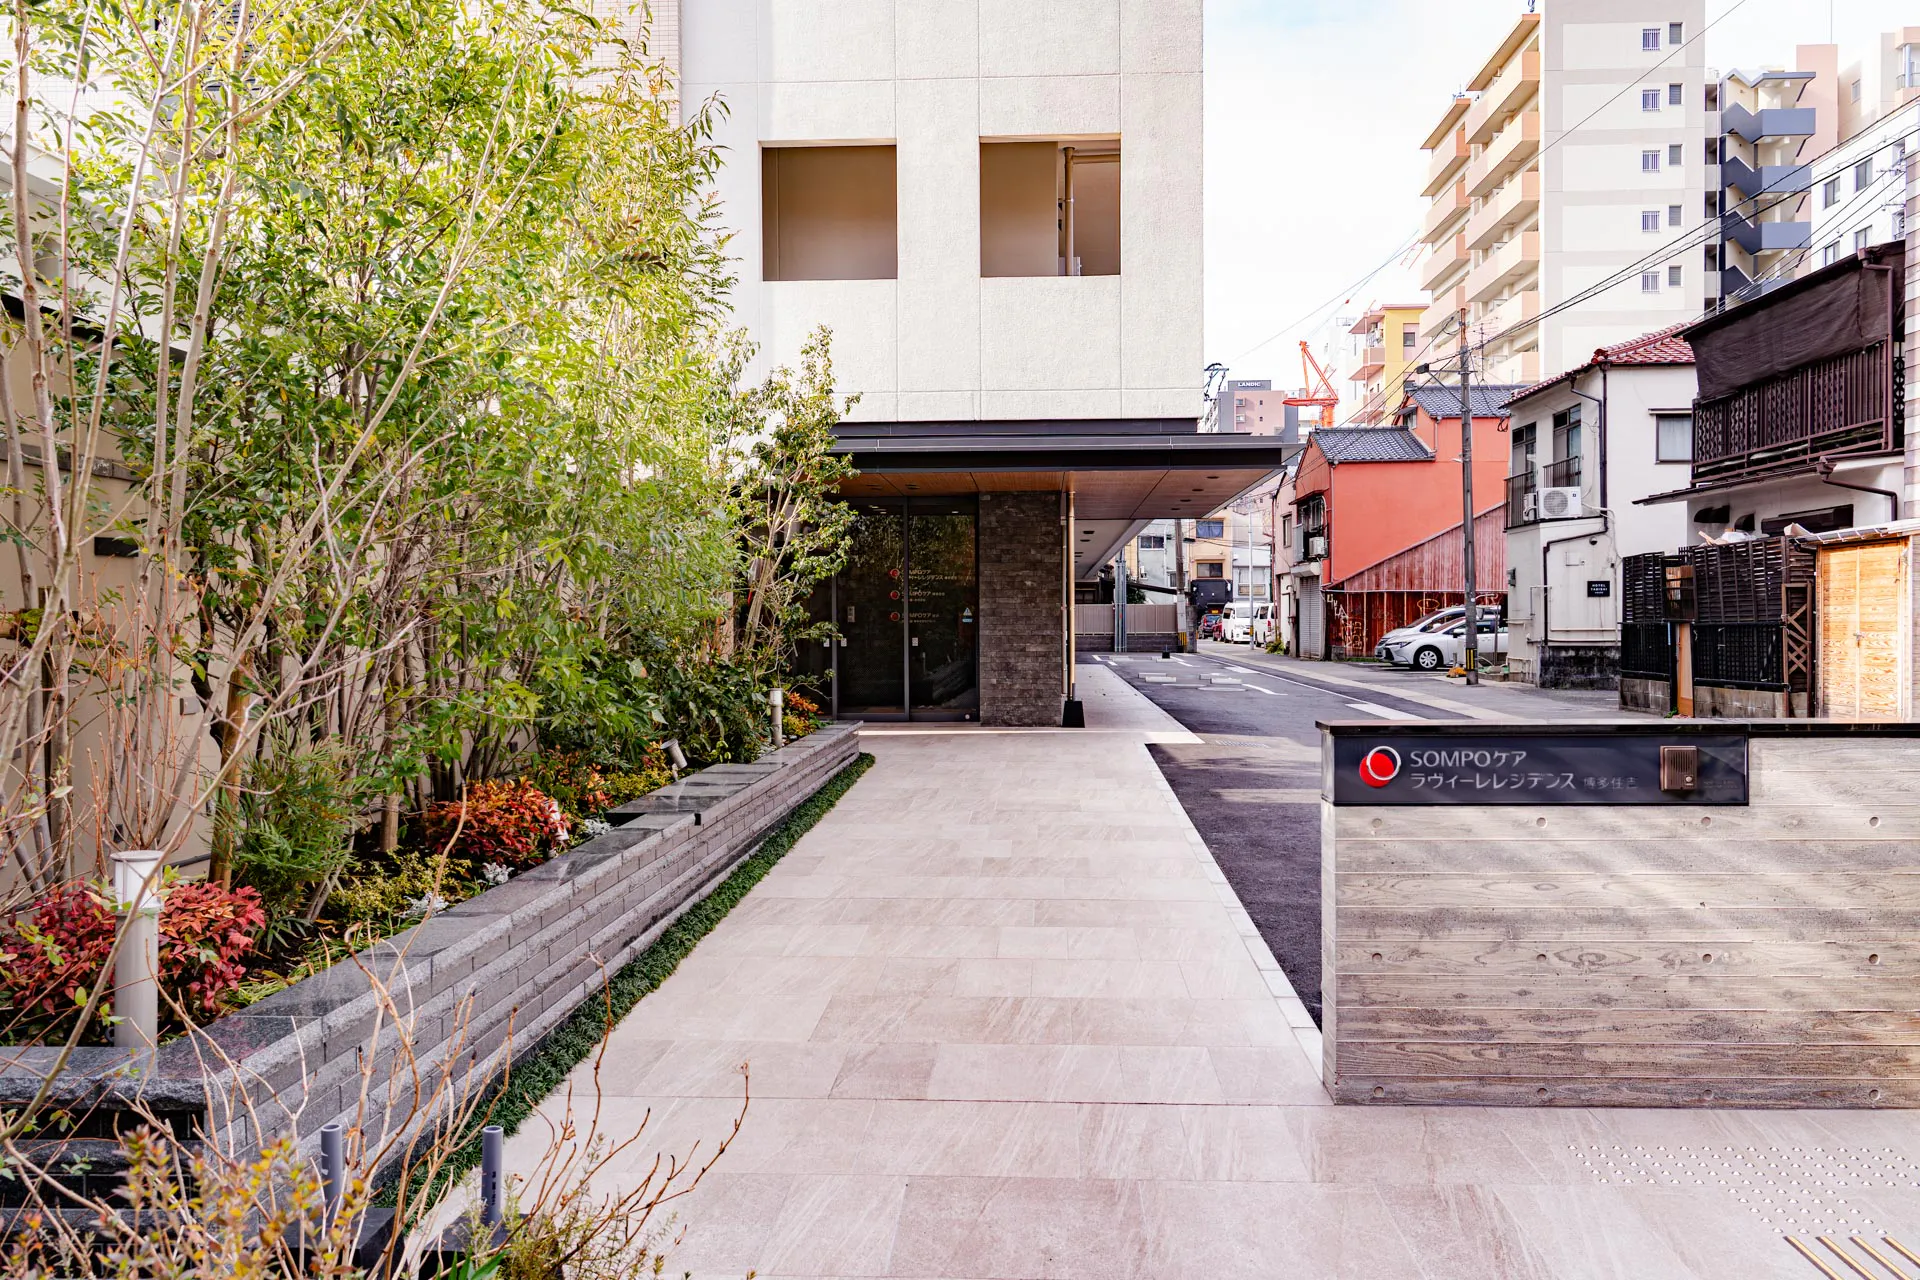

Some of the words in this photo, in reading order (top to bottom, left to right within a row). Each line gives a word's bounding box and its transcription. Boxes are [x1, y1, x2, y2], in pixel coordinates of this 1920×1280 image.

[1410, 750, 1527, 768] SOMPOケア
[1410, 772, 1577, 790] ラヴィーレレジデンス
